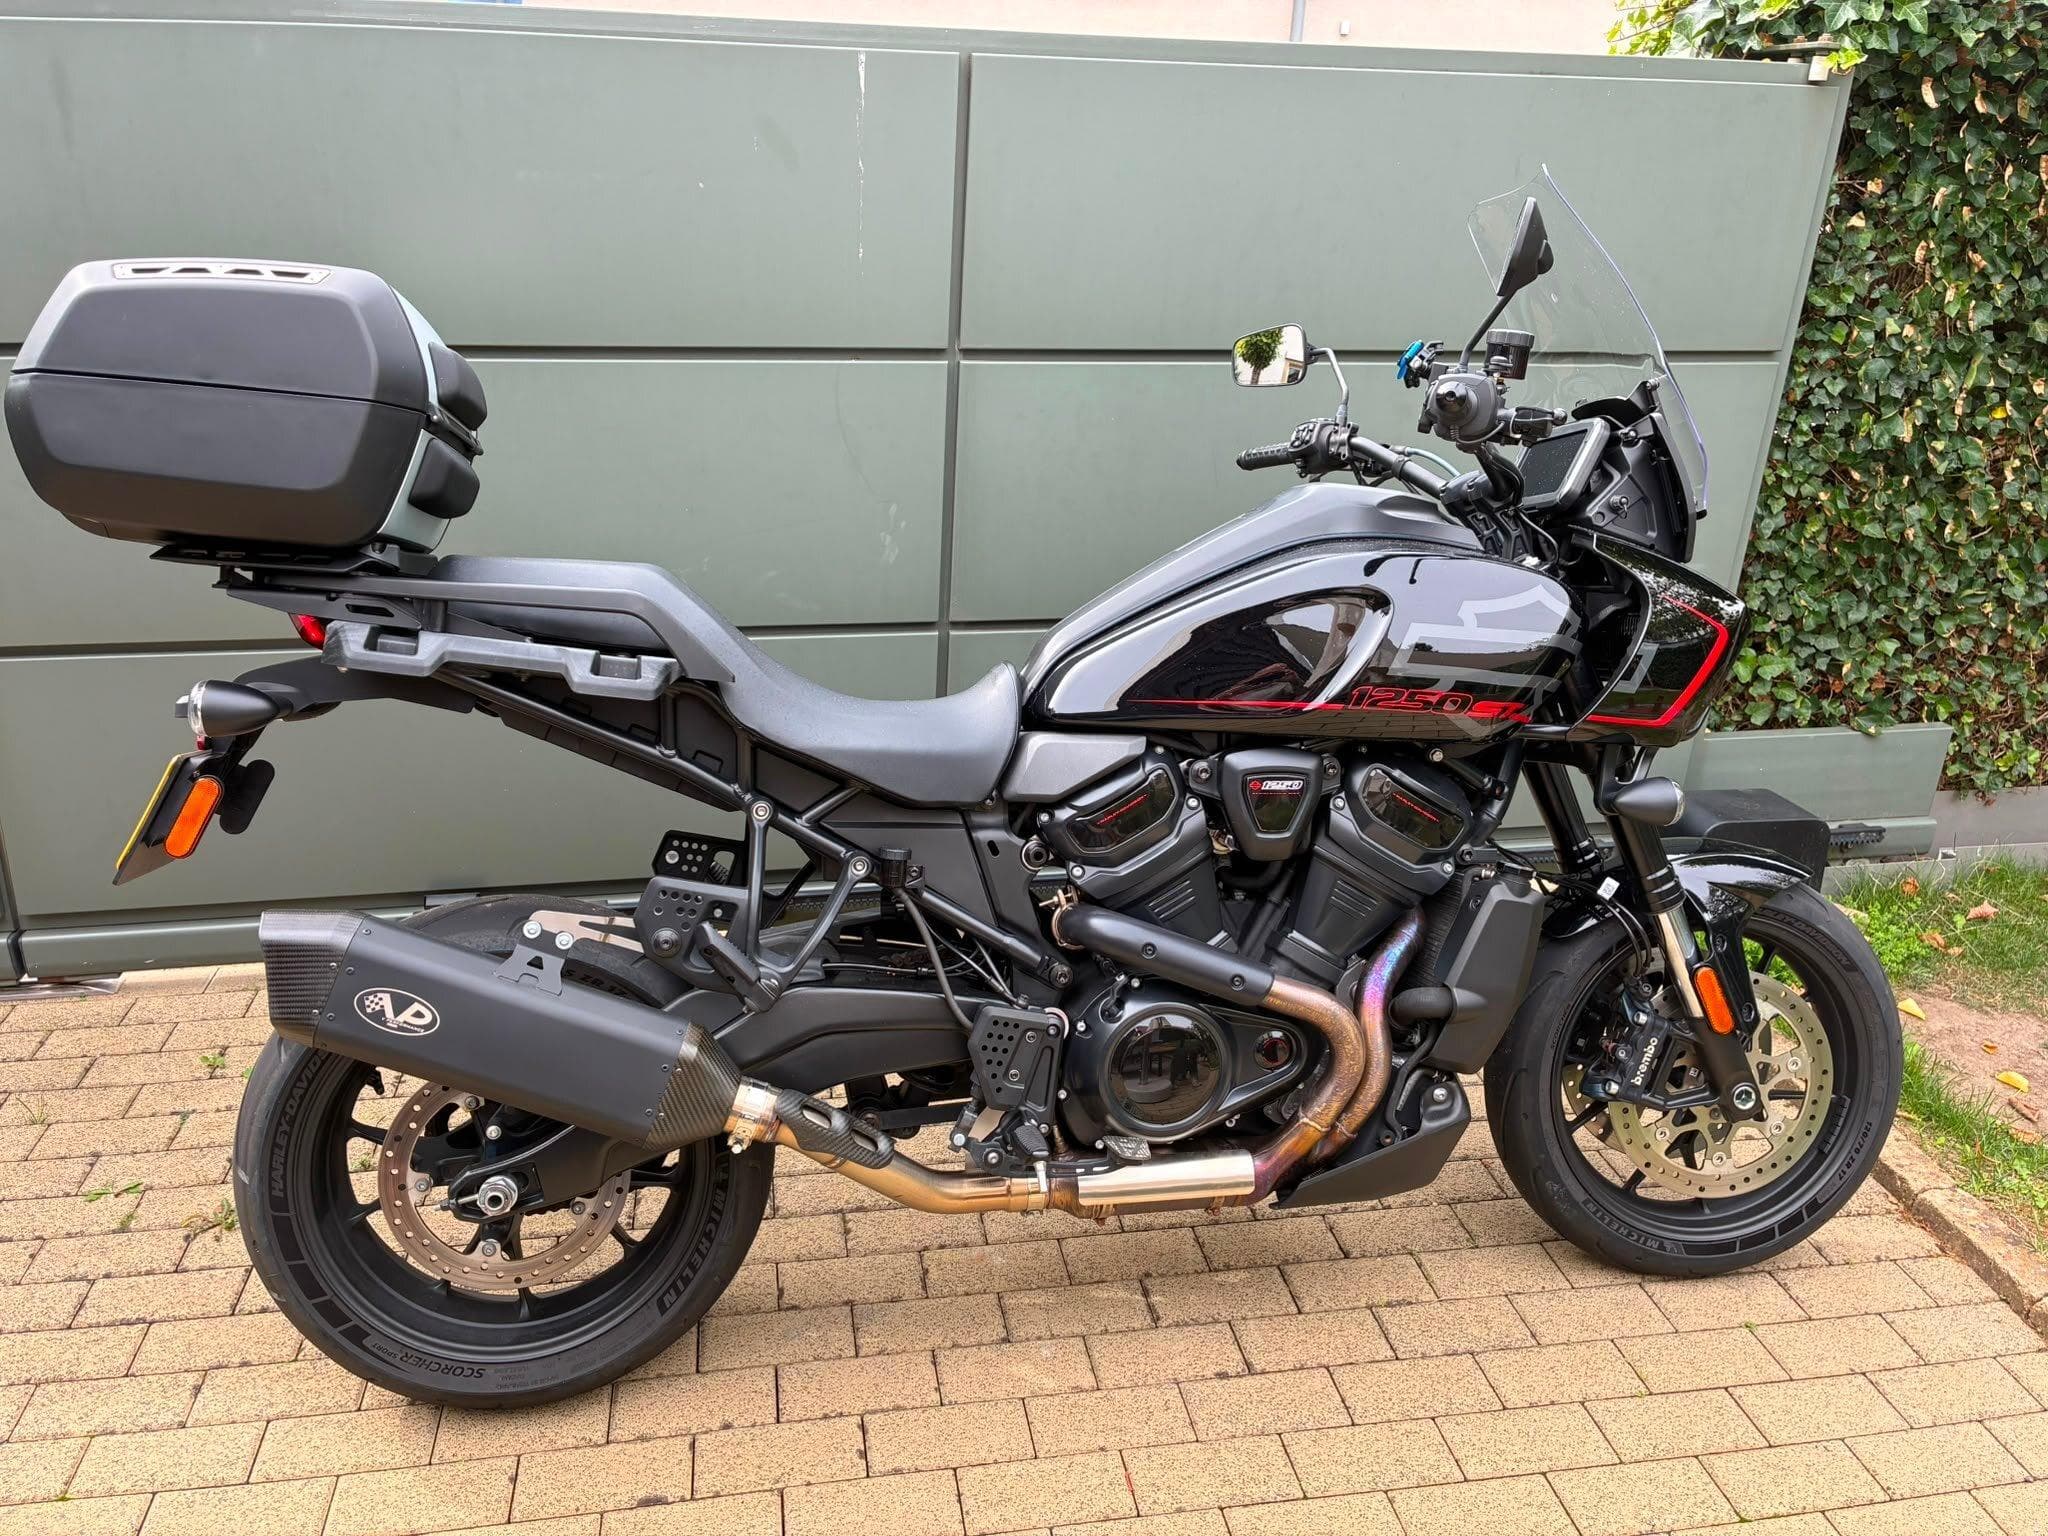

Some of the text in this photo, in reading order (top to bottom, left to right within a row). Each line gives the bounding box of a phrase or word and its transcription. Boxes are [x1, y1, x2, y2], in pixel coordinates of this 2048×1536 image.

[1347, 685, 1473, 715] 1250
[1261, 780, 1304, 790] 1250
[1630, 1037, 1658, 1086] brembo
[1838, 1121, 1873, 1180] 120/70 ZR 17
[662, 1187, 727, 1311] MICHELIN
[1585, 1202, 1660, 1249] MICHELIN
[372, 1342, 486, 1379] SCORCHER SPORT
